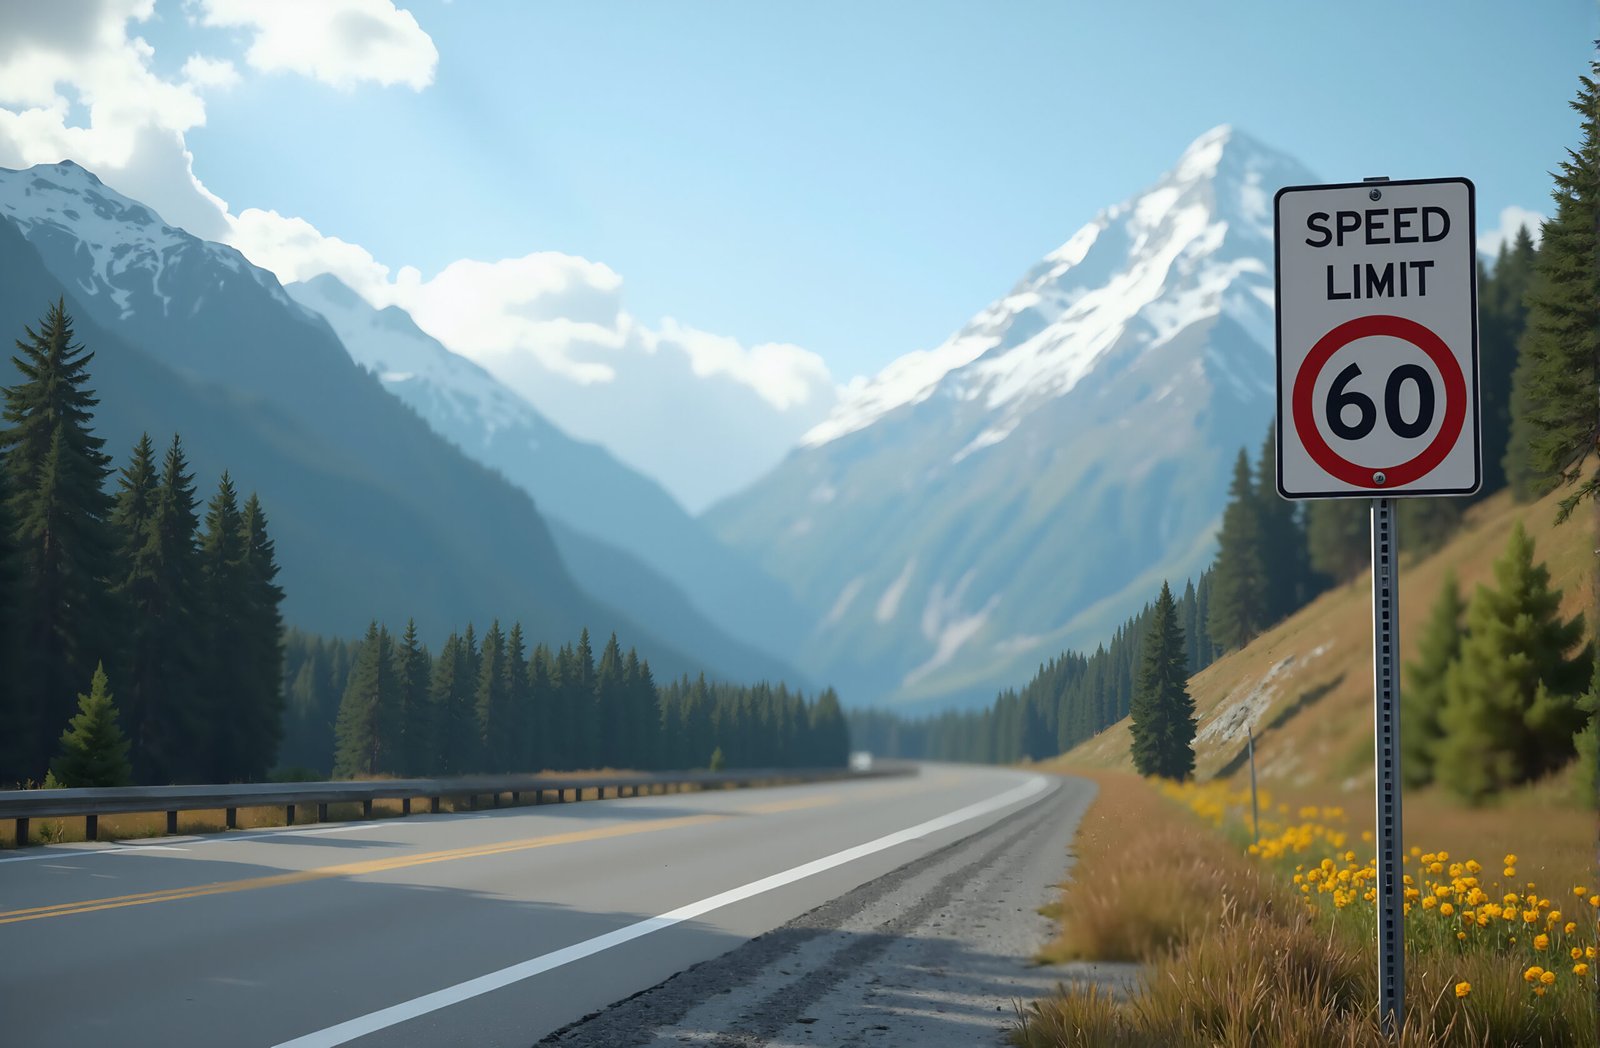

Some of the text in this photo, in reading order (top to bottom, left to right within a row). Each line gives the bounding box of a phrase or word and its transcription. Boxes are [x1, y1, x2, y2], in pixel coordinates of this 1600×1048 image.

[1305, 206, 1451, 248] SPEED
[1326, 260, 1435, 300] LIMIT
[1325, 362, 1435, 441] 60
